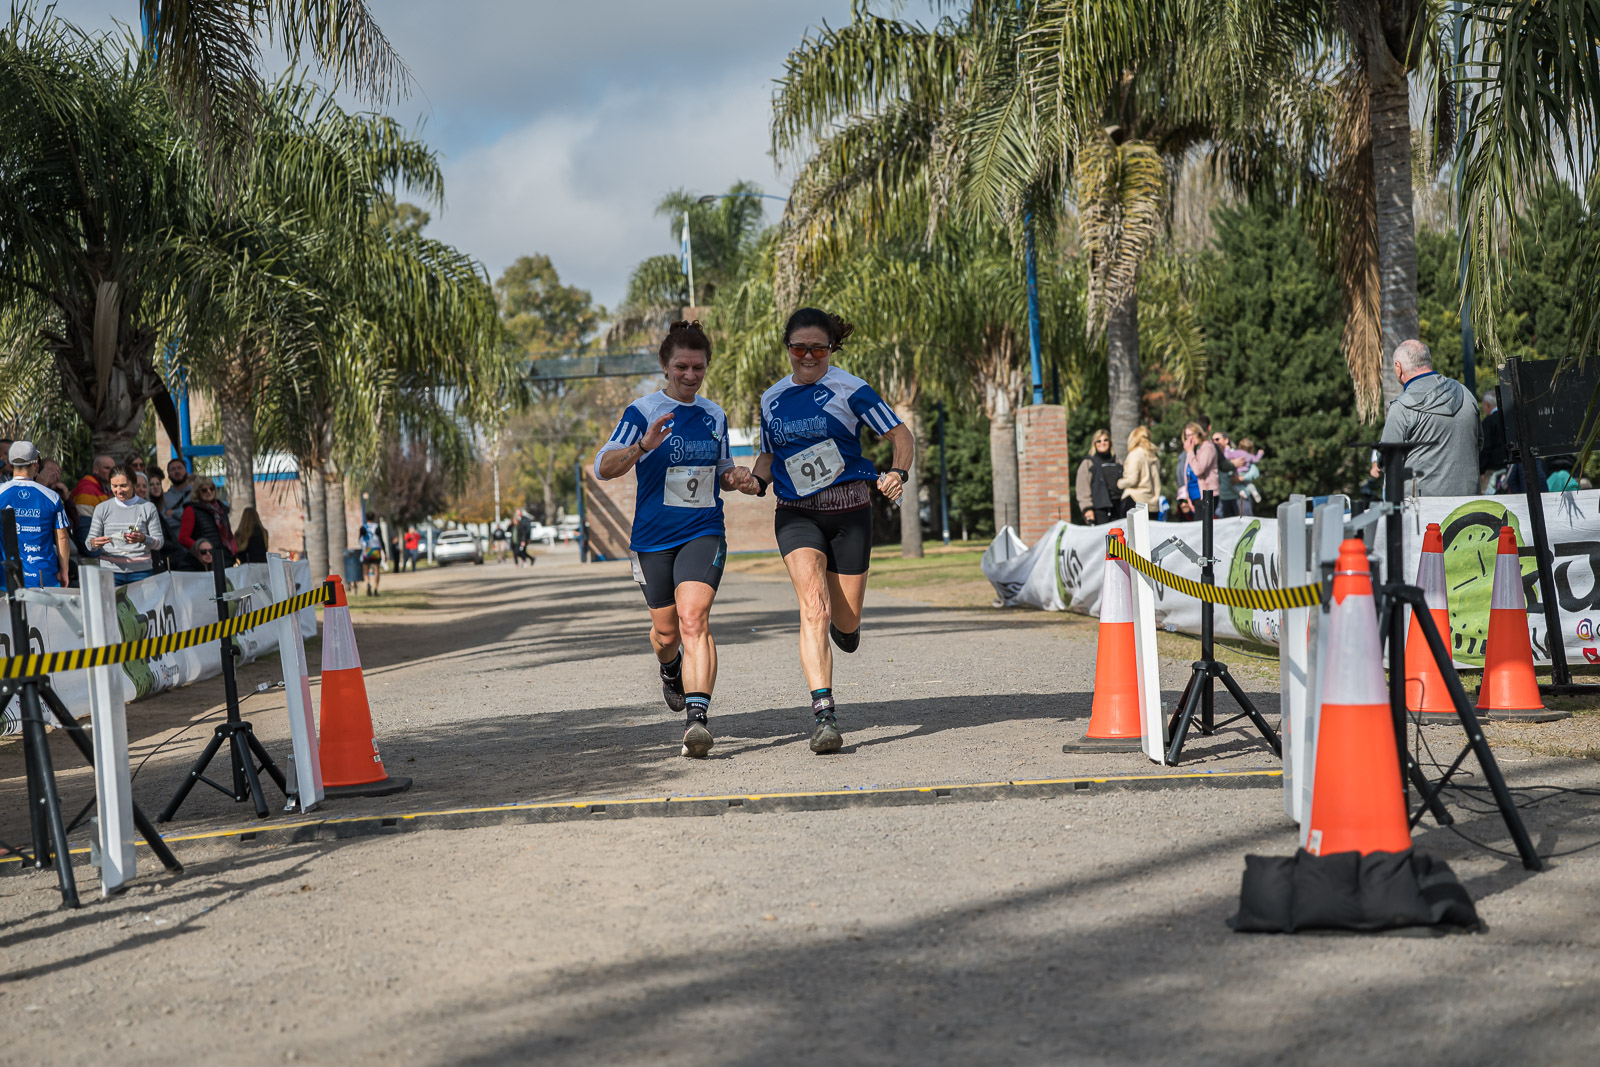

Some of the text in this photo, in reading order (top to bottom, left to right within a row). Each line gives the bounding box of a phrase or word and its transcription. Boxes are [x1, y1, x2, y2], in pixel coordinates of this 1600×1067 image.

[771, 417, 786, 446] 3
[670, 435, 684, 463] 3
[801, 456, 832, 482] 91
[687, 478, 699, 498] 9
